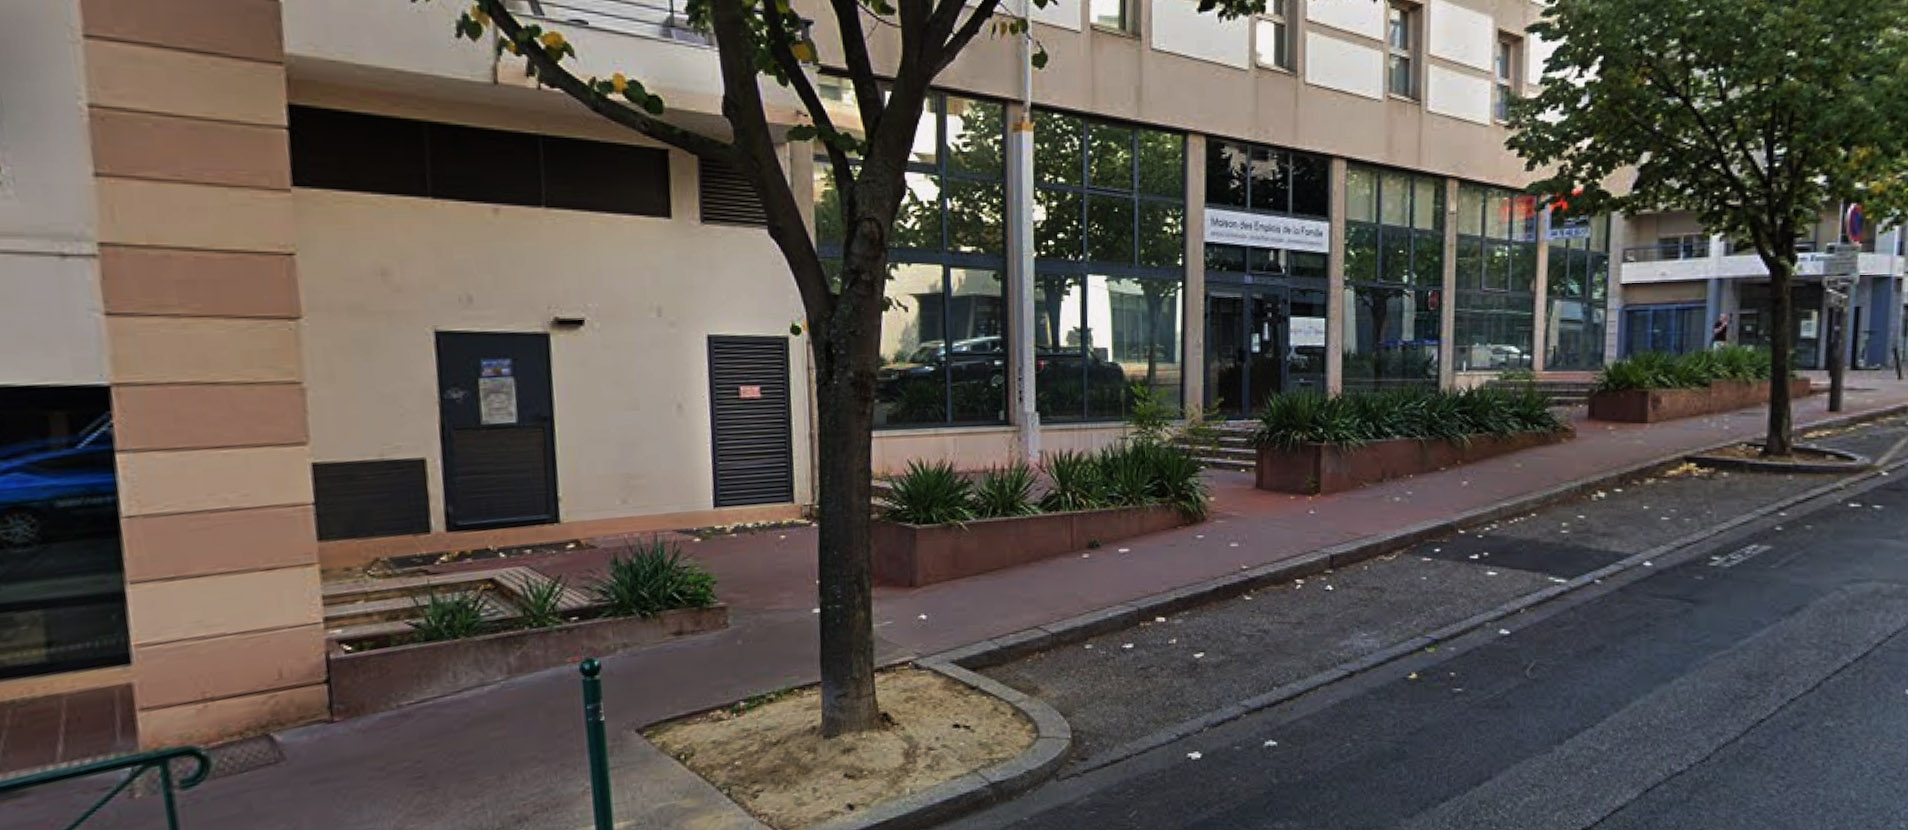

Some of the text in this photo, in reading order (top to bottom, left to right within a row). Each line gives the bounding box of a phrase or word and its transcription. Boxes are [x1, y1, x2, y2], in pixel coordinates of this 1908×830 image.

[1210, 216, 1237, 229] Maison
[1240, 219, 1252, 231] des
[1282, 224, 1292, 235] de
